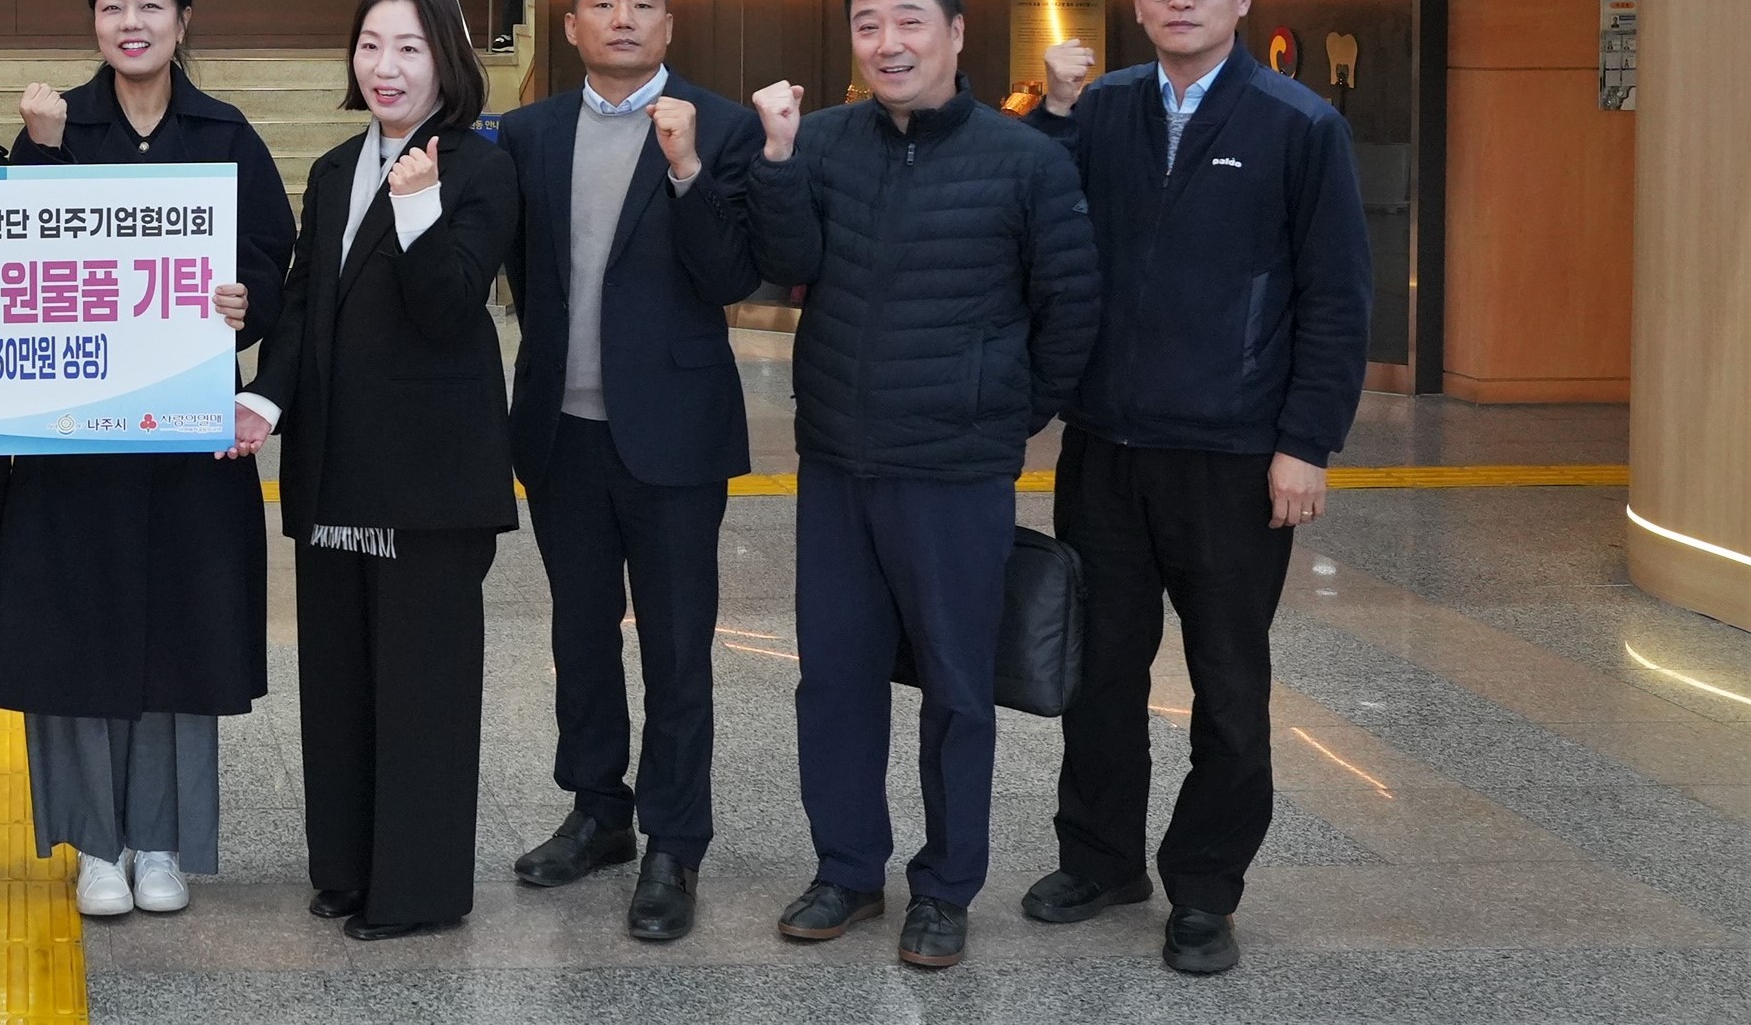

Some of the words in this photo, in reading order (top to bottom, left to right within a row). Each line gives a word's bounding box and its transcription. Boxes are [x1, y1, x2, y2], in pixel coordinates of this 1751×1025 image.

[38, 205, 214, 239] 입주기업협의회
[133, 256, 213, 320] 기탁
[62, 332, 108, 380] 상당)
[87, 418, 127, 431] 나주시
